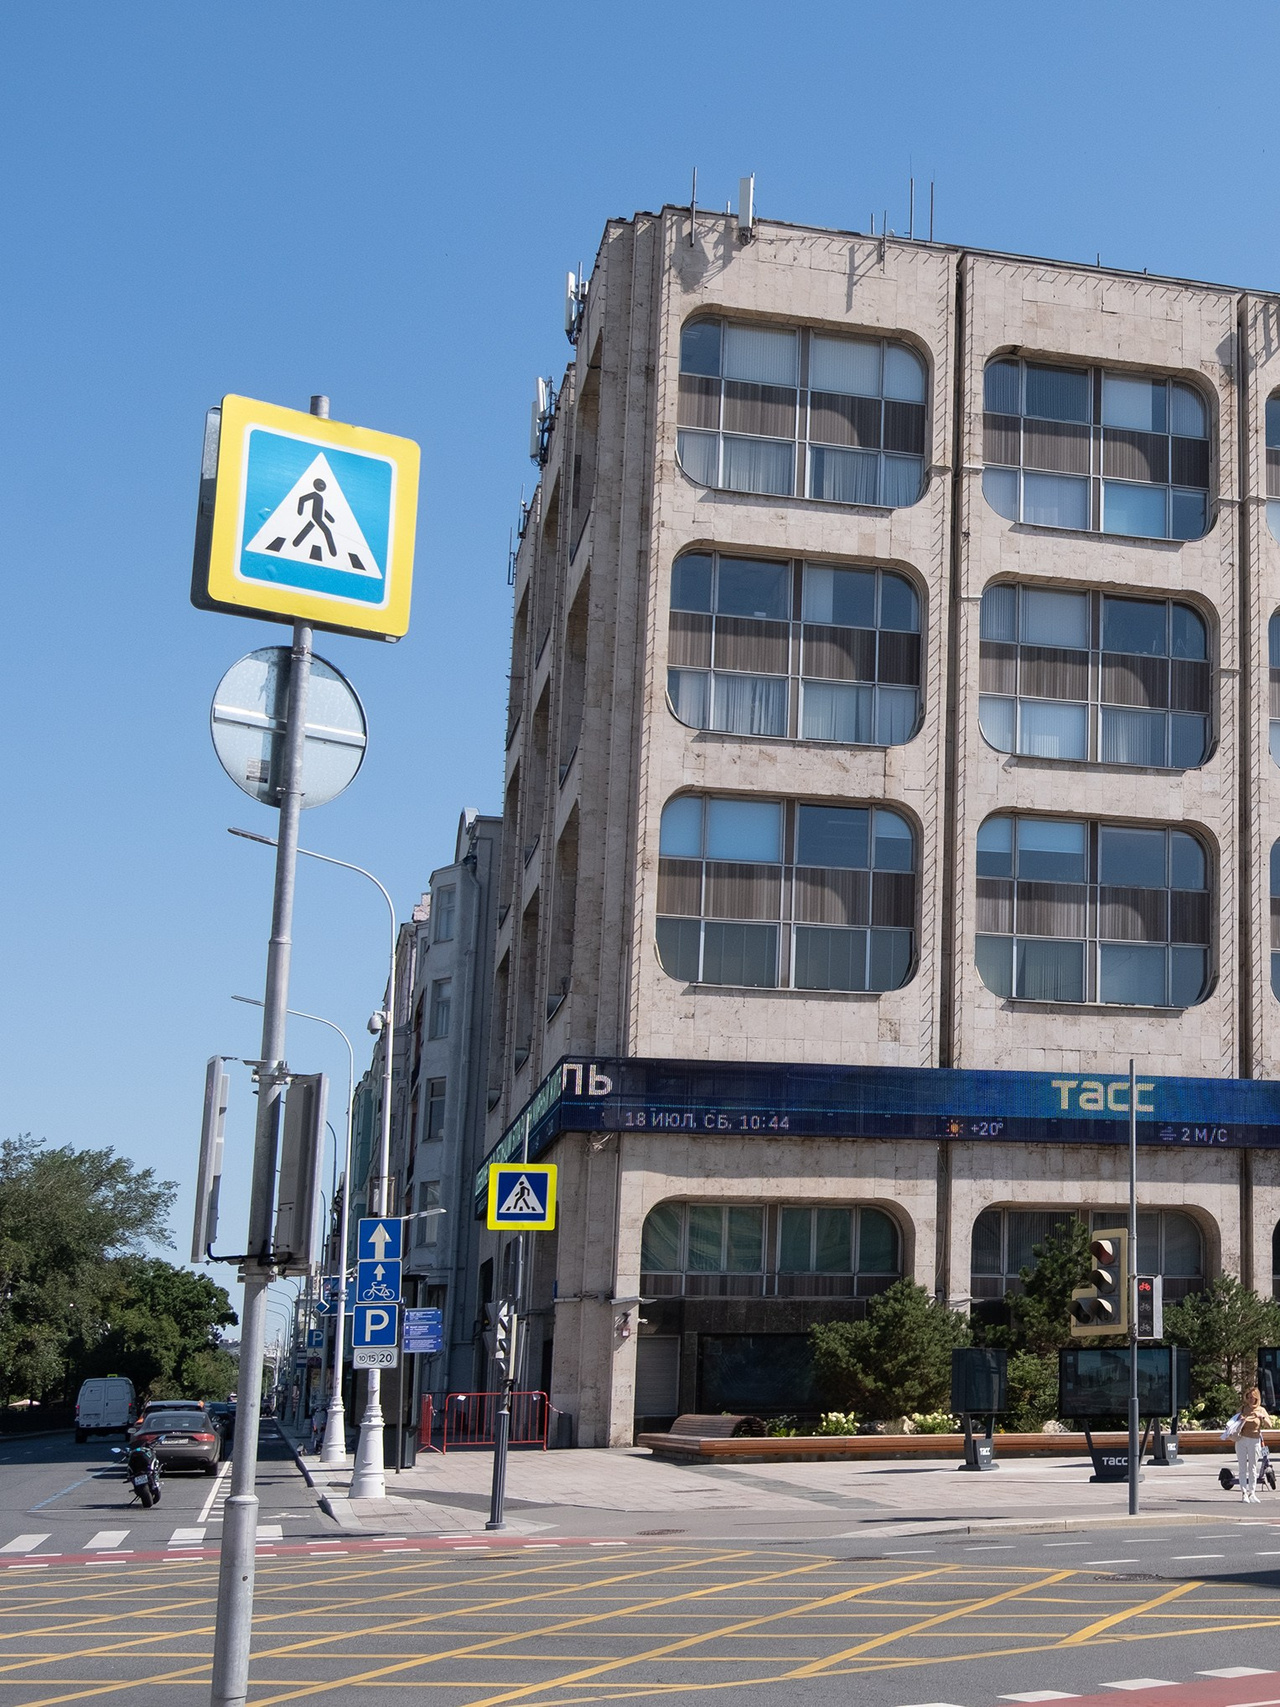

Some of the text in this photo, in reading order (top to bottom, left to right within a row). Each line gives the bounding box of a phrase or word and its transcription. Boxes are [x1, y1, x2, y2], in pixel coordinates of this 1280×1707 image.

[625, 1111, 646, 1127] 18
[740, 1115, 790, 1131] 10:44
[971, 1121, 1004, 1136] +20°
[1181, 1127, 1228, 1145] 2 М/С
[365, 1309, 389, 1342] P
[368, 1354, 376, 1362] 15
[379, 1353, 392, 1362] 20
